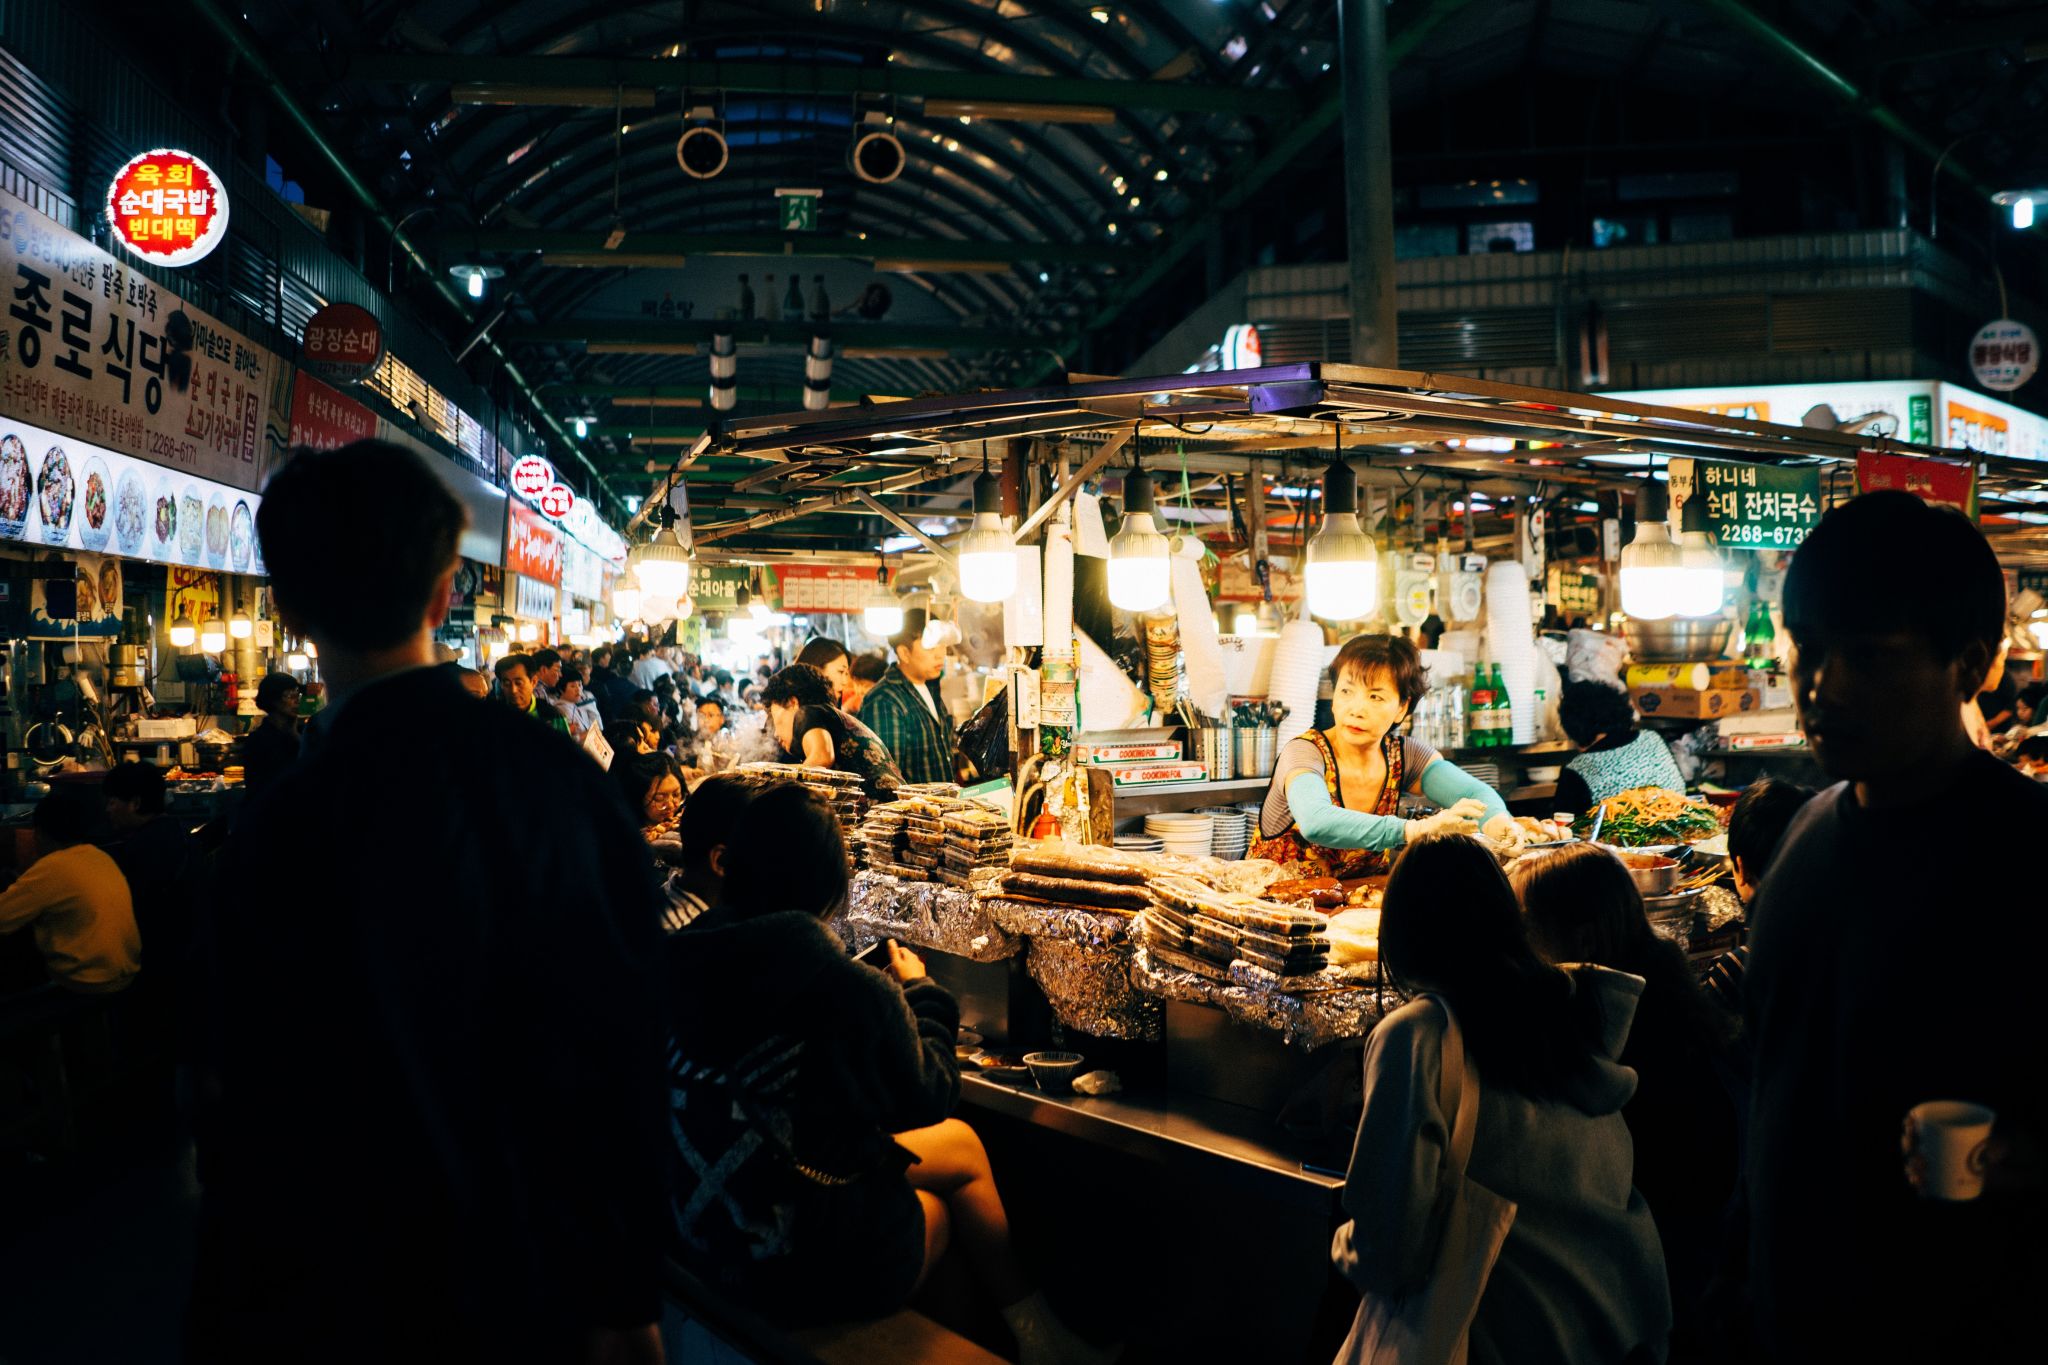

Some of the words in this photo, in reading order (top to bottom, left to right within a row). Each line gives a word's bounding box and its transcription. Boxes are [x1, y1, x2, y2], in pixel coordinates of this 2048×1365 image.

[134, 164, 193, 186] 육회
[119, 189, 210, 215] 순대국밥
[129, 218, 197, 240] 빈대떡
[102, 263, 125, 304] 팥죽
[127, 278, 158, 322] 호박죽
[9, 263, 169, 415] 종로식당
[308, 326, 377, 355] 광장순대
[3, 370, 49, 418] 녹두빈대떡
[51, 386, 84, 430] 해물파전
[184, 404, 242, 459] 소고기장국밥
[1705, 466, 1757, 487] 하니네
[1707, 490, 1738, 520] 순대
[1744, 491, 1817, 523] 잔치국수
[1119, 749, 1145, 759] COOKING
[1146, 749, 1157, 757] FOIL
[1141, 770, 1170, 780] COOKING
[1170, 769, 1182, 778] FOIL
